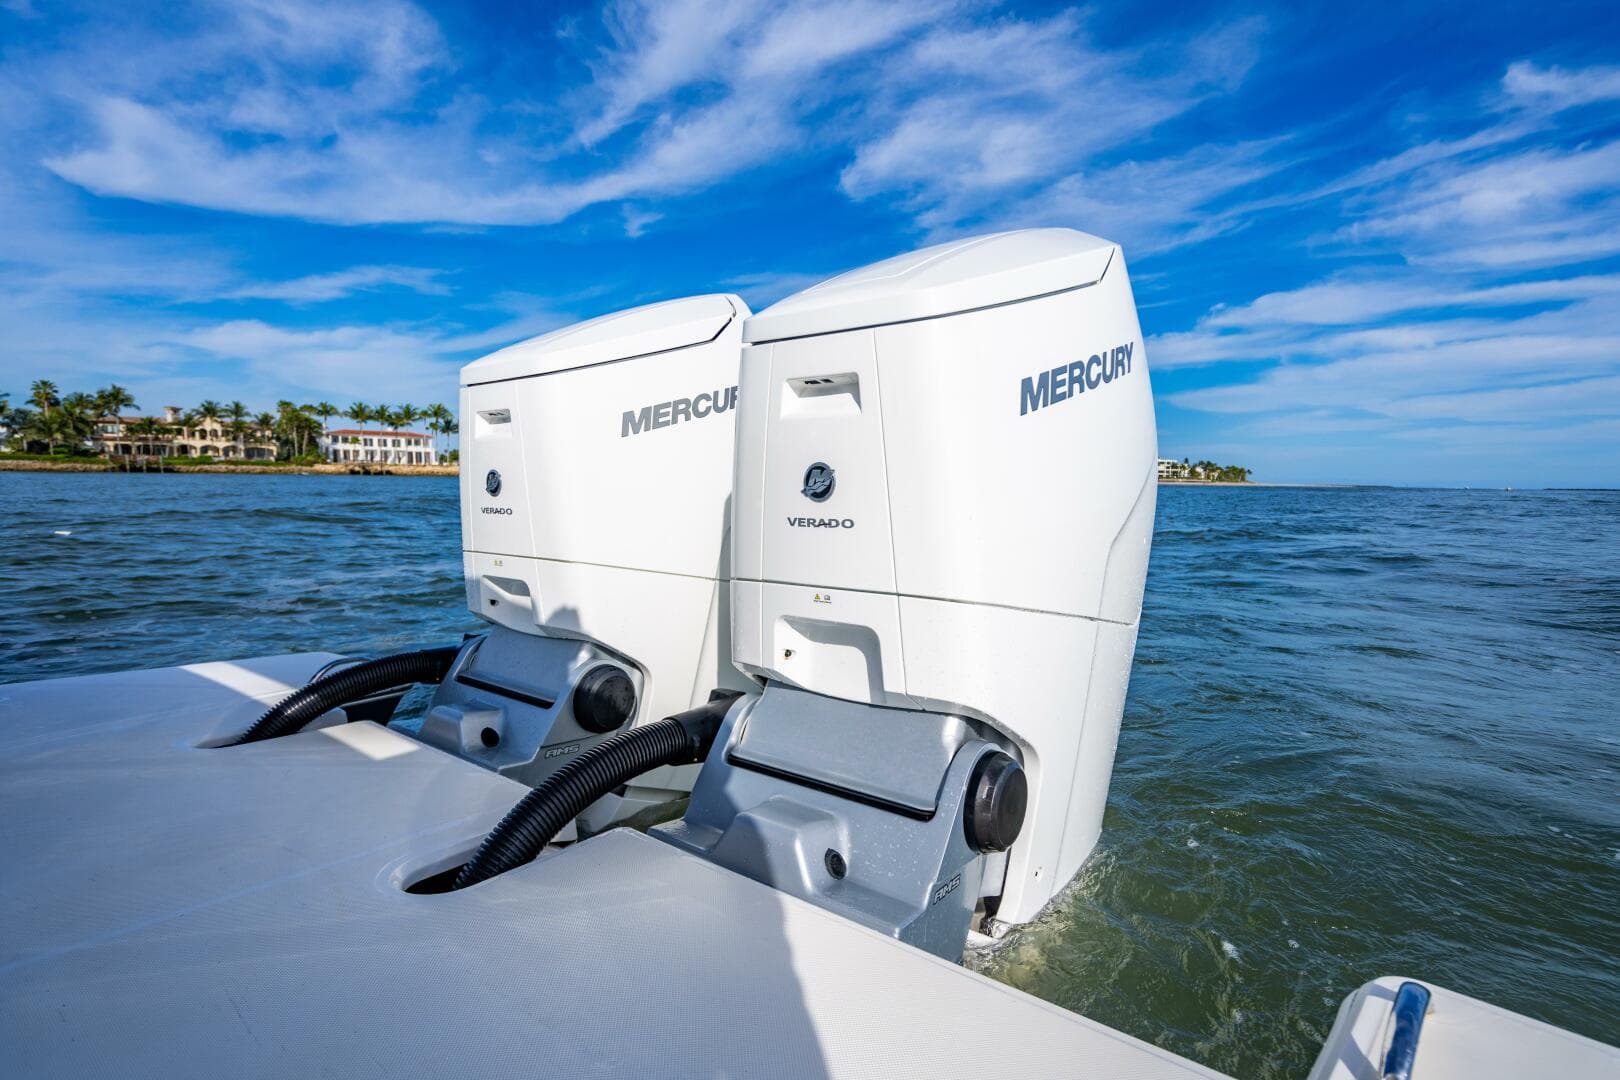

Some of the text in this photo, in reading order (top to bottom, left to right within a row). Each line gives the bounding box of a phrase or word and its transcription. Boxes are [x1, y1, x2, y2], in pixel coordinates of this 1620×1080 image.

[1020, 341, 1134, 416] MERCURY
[480, 506, 513, 516] VERADO
[787, 516, 855, 529] VERADO
